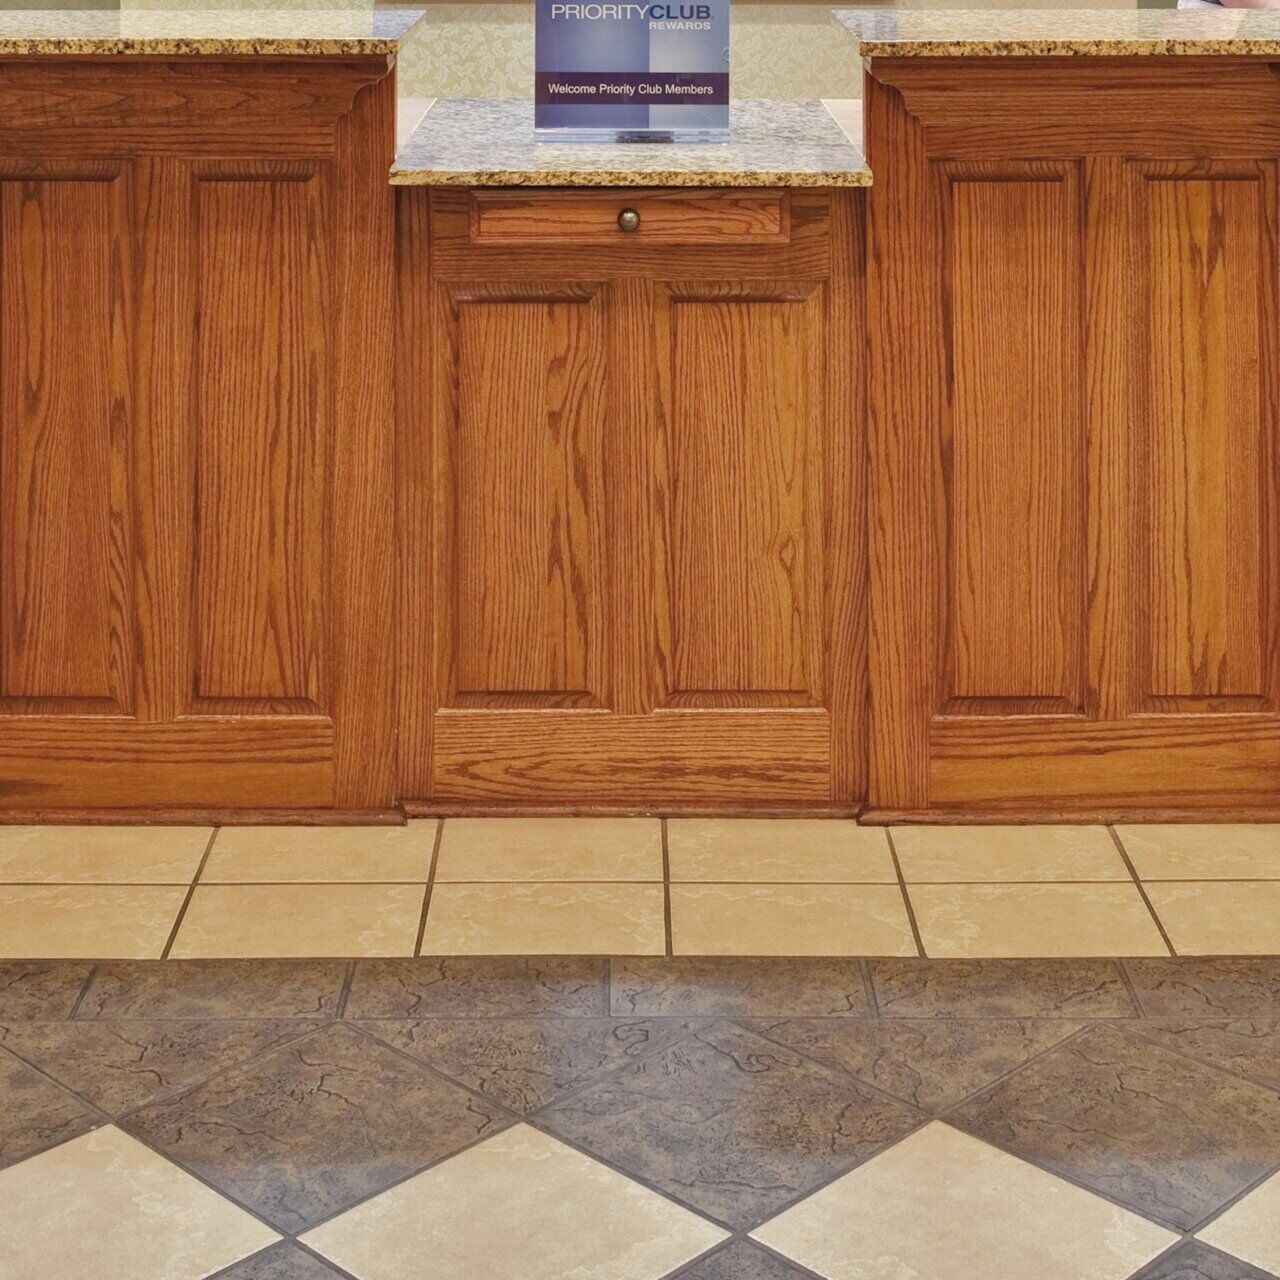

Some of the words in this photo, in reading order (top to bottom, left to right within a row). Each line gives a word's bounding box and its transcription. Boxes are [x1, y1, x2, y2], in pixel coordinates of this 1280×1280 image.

[649, 22, 711, 30] REWARDS
[548, 83, 596, 94] Welcome
[599, 83, 635, 96] Priority
[638, 83, 662, 94] Club
[665, 83, 714, 95] Members
